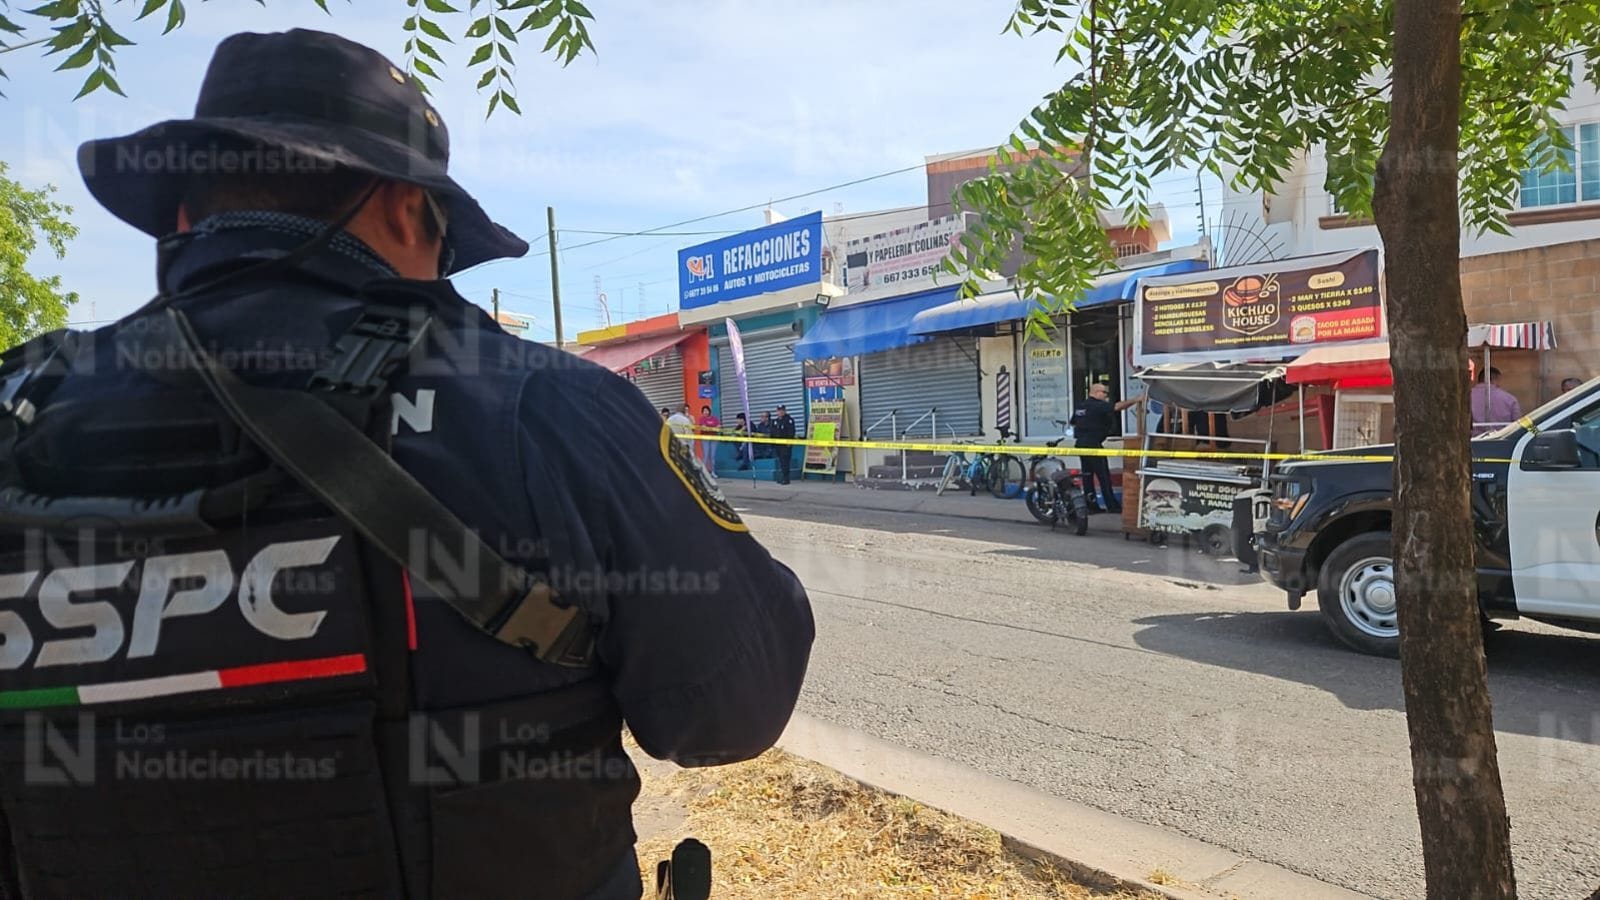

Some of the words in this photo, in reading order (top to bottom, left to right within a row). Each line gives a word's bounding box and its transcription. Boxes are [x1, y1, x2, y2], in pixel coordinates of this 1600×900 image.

[723, 229, 810, 275] REFACCIONES
[868, 252, 874, 263] Y
[874, 243, 912, 262] PAPELERIA
[724, 277, 746, 290] AUTOS
[748, 276, 754, 285] Y
[754, 262, 810, 280] MOTOCICLETAS
[883, 272, 900, 284] 667
[901, 267, 920, 280] 333
[1321, 290, 1345, 299] TIERRA
[1227, 304, 1275, 317] KICHIJO
[1297, 302, 1325, 312] QUESOS
[1232, 315, 1270, 327] HOUSE
[1317, 321, 1340, 329] TACOS
[1351, 316, 1375, 325] ASADA
[1318, 329, 1332, 337] POR
[1344, 325, 1375, 334] MAÑANA
[1196, 483, 1215, 491] HOT
[1207, 500, 1233, 509] PAPAS
